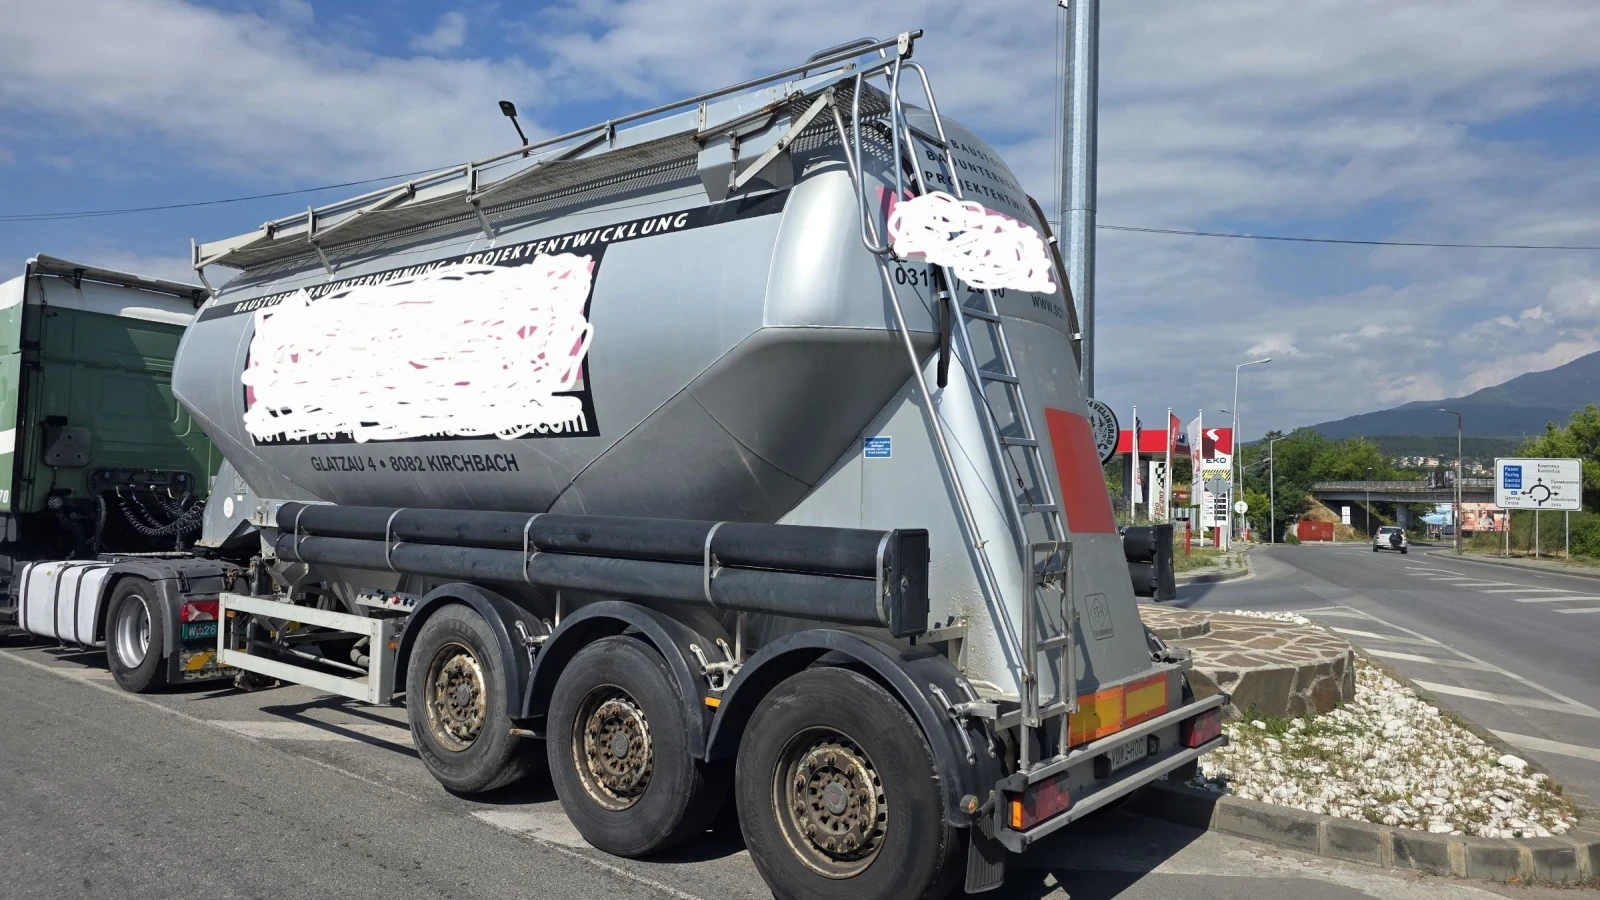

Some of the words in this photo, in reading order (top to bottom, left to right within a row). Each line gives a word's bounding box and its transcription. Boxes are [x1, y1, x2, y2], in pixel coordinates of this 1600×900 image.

[463, 213, 689, 266] PROJEKTENTWICKLUNG
[311, 456, 365, 472] GLATZAU
[368, 456, 377, 472] 4
[389, 455, 426, 472] 8082
[426, 454, 520, 472] KIRCHBACH
